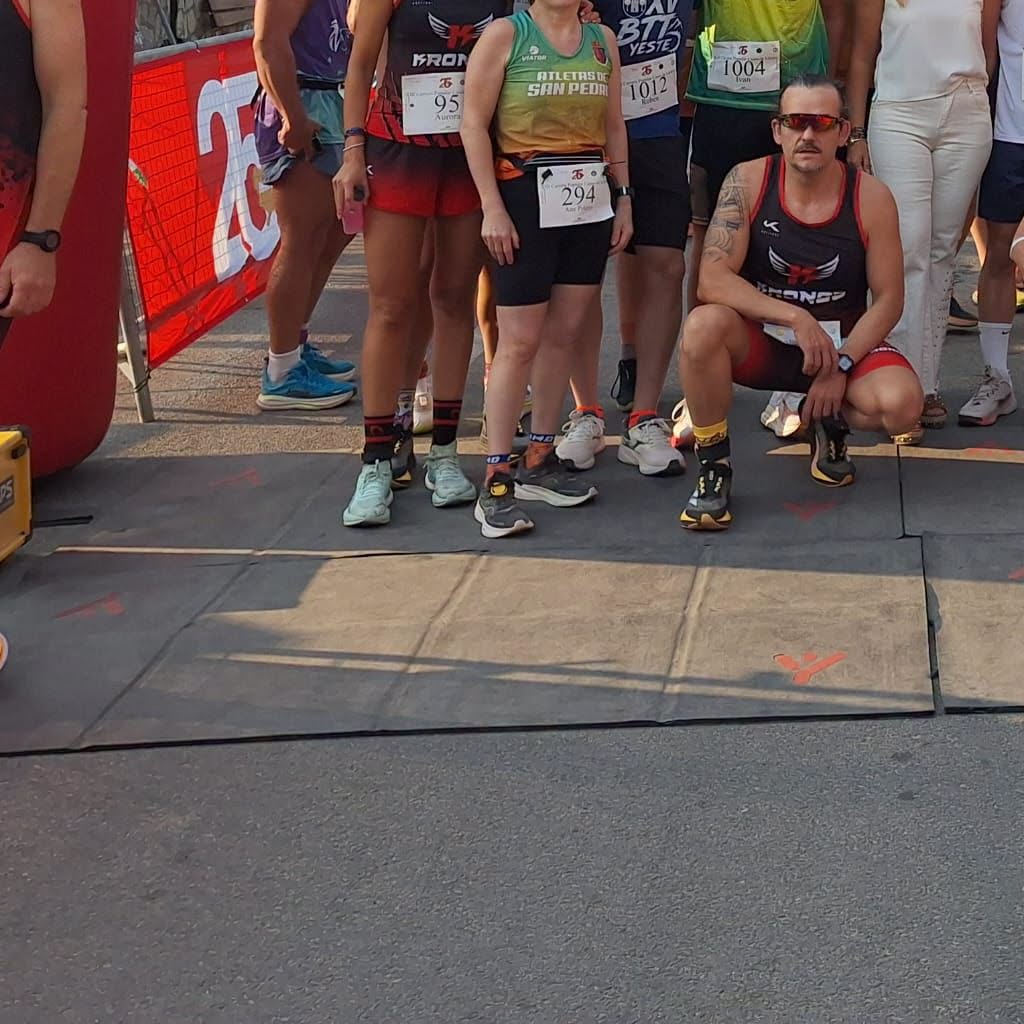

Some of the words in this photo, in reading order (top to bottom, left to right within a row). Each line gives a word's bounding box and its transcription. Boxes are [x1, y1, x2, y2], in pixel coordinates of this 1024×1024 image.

[617, 13, 677, 46] BTT
[630, 38, 672, 56] YESTE
[537, 71, 596, 81] ATLETAS
[723, 59, 766, 77] 1004
[528, 82, 565, 96] SAN
[630, 76, 668, 101] 1012
[434, 94, 460, 114] 95
[561, 184, 596, 207] 294
